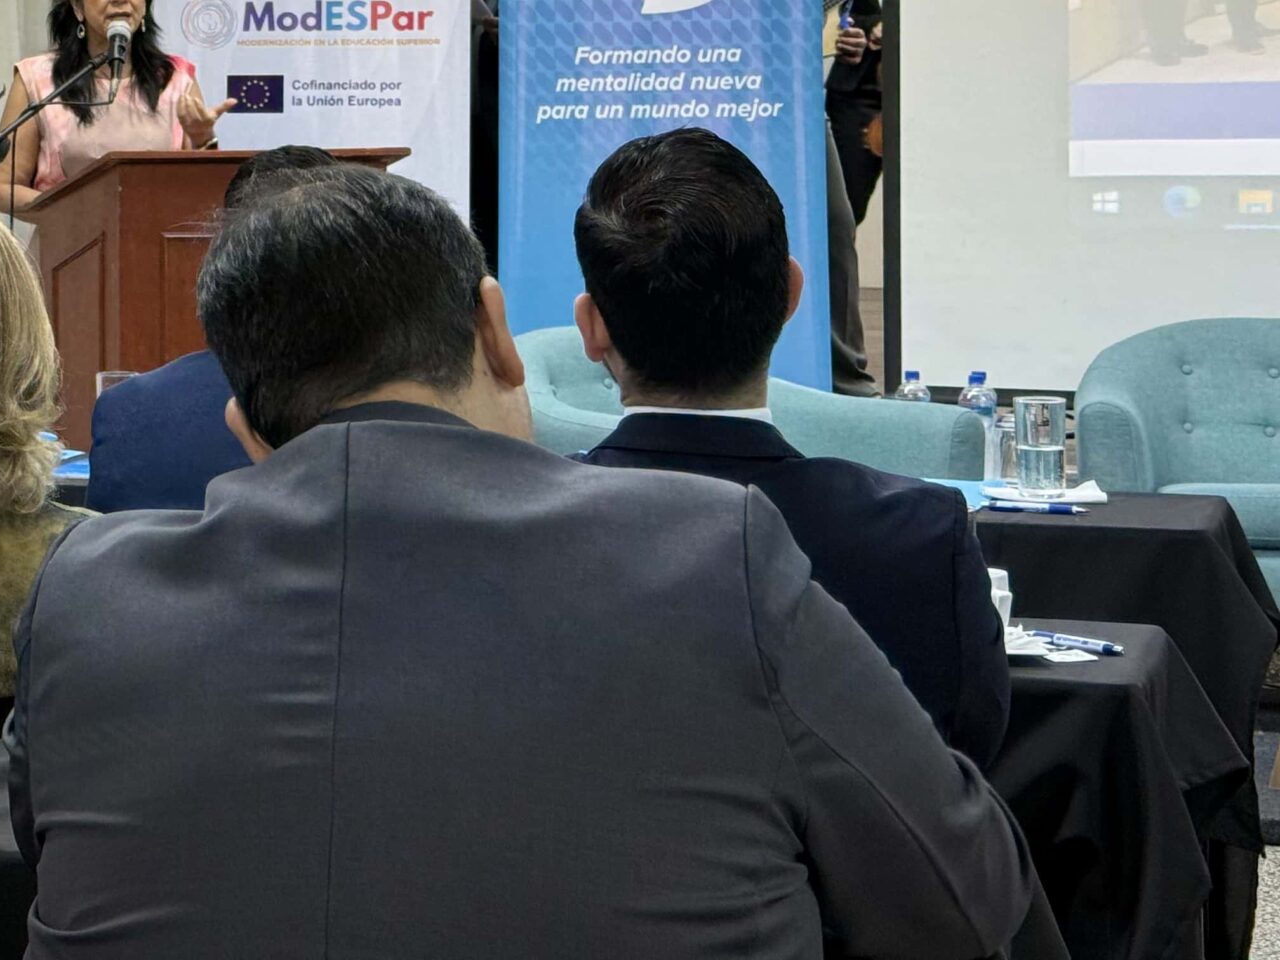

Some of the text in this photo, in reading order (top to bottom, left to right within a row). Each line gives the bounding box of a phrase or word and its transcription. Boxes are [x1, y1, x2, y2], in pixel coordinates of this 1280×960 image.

[242, 0, 435, 32] ModESPar
[236, 37, 312, 47] MODERNIZACIÓN
[327, 38, 340, 46] LA
[341, 37, 394, 46] EDUCACIÓN
[396, 38, 441, 46] SUPERIOR
[574, 45, 742, 65] Formando una
[291, 79, 402, 93] Cofinanciado por
[556, 72, 762, 92] mentalidad nueva
[291, 95, 402, 109] la Unión Europea
[536, 98, 783, 124] para un mundo mejor
